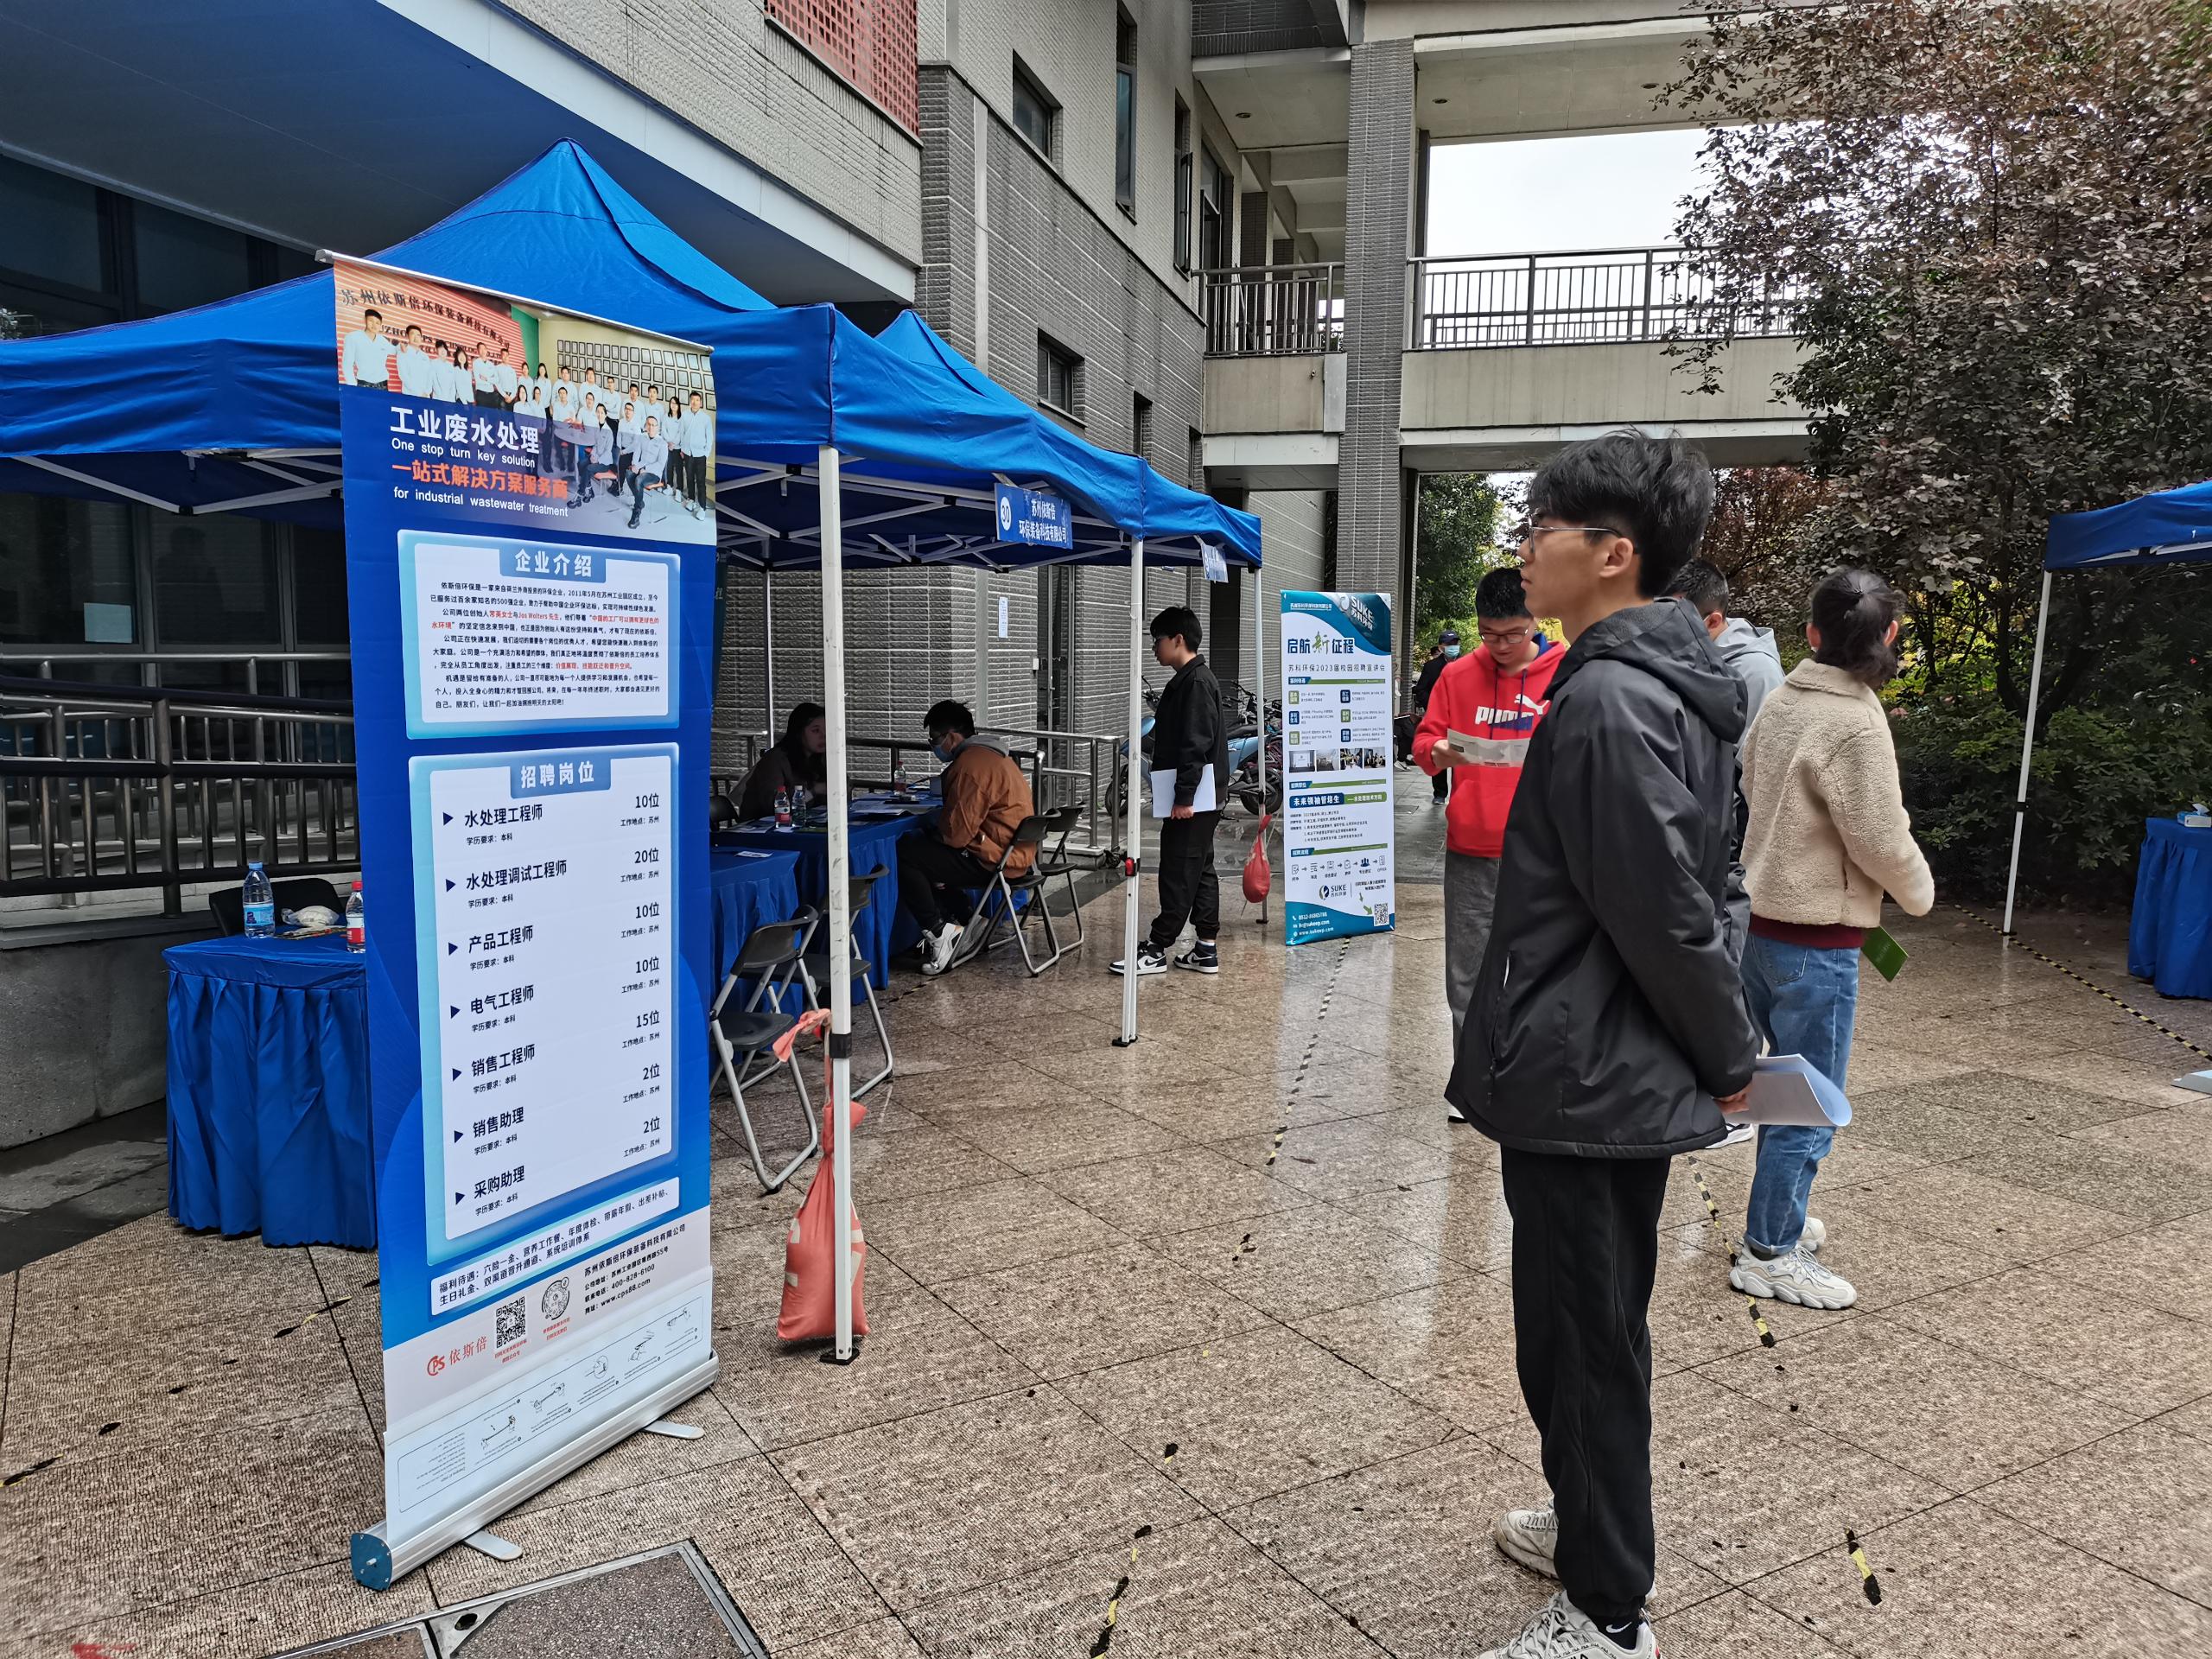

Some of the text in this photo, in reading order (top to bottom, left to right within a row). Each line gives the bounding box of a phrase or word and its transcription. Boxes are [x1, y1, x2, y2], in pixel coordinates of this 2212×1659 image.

[391, 406, 540, 454] 工业废水处理
[391, 438, 536, 468] One stop turn key solution
[391, 459, 569, 500] 一站式解决方案服务商
[393, 486, 569, 518] for industrial wastewater treatment
[1001, 505, 1010, 524] 30
[1031, 499, 1056, 520] 苏州依斯倍
[1019, 519, 1067, 543] 环保装备科技有限公司
[514, 549, 592, 577] 企业介绍
[1351, 596, 1373, 623] SUKE
[1287, 631, 1355, 655] 启航新征程
[520, 760, 594, 789] 招聘岗位
[635, 792, 659, 809] 10位
[1294, 795, 1340, 807] 未来领袖管培生
[464, 804, 543, 828] 水处理工程师
[634, 847, 659, 864] 20位
[466, 860, 568, 891] 水处理调试工程师
[635, 901, 659, 919] 10位
[468, 925, 534, 954] 产品工程师
[635, 957, 659, 974] 10位
[470, 984, 534, 1014] 电气工程师
[636, 1009, 659, 1028] 15位
[471, 1043, 536, 1077] 销售工程师
[642, 1063, 660, 1081] 2位
[473, 1106, 524, 1139] 销售助理
[643, 1116, 660, 1134] 2位
[474, 1165, 525, 1200] 采购助理
[449, 1337, 486, 1365] 依斯倍
